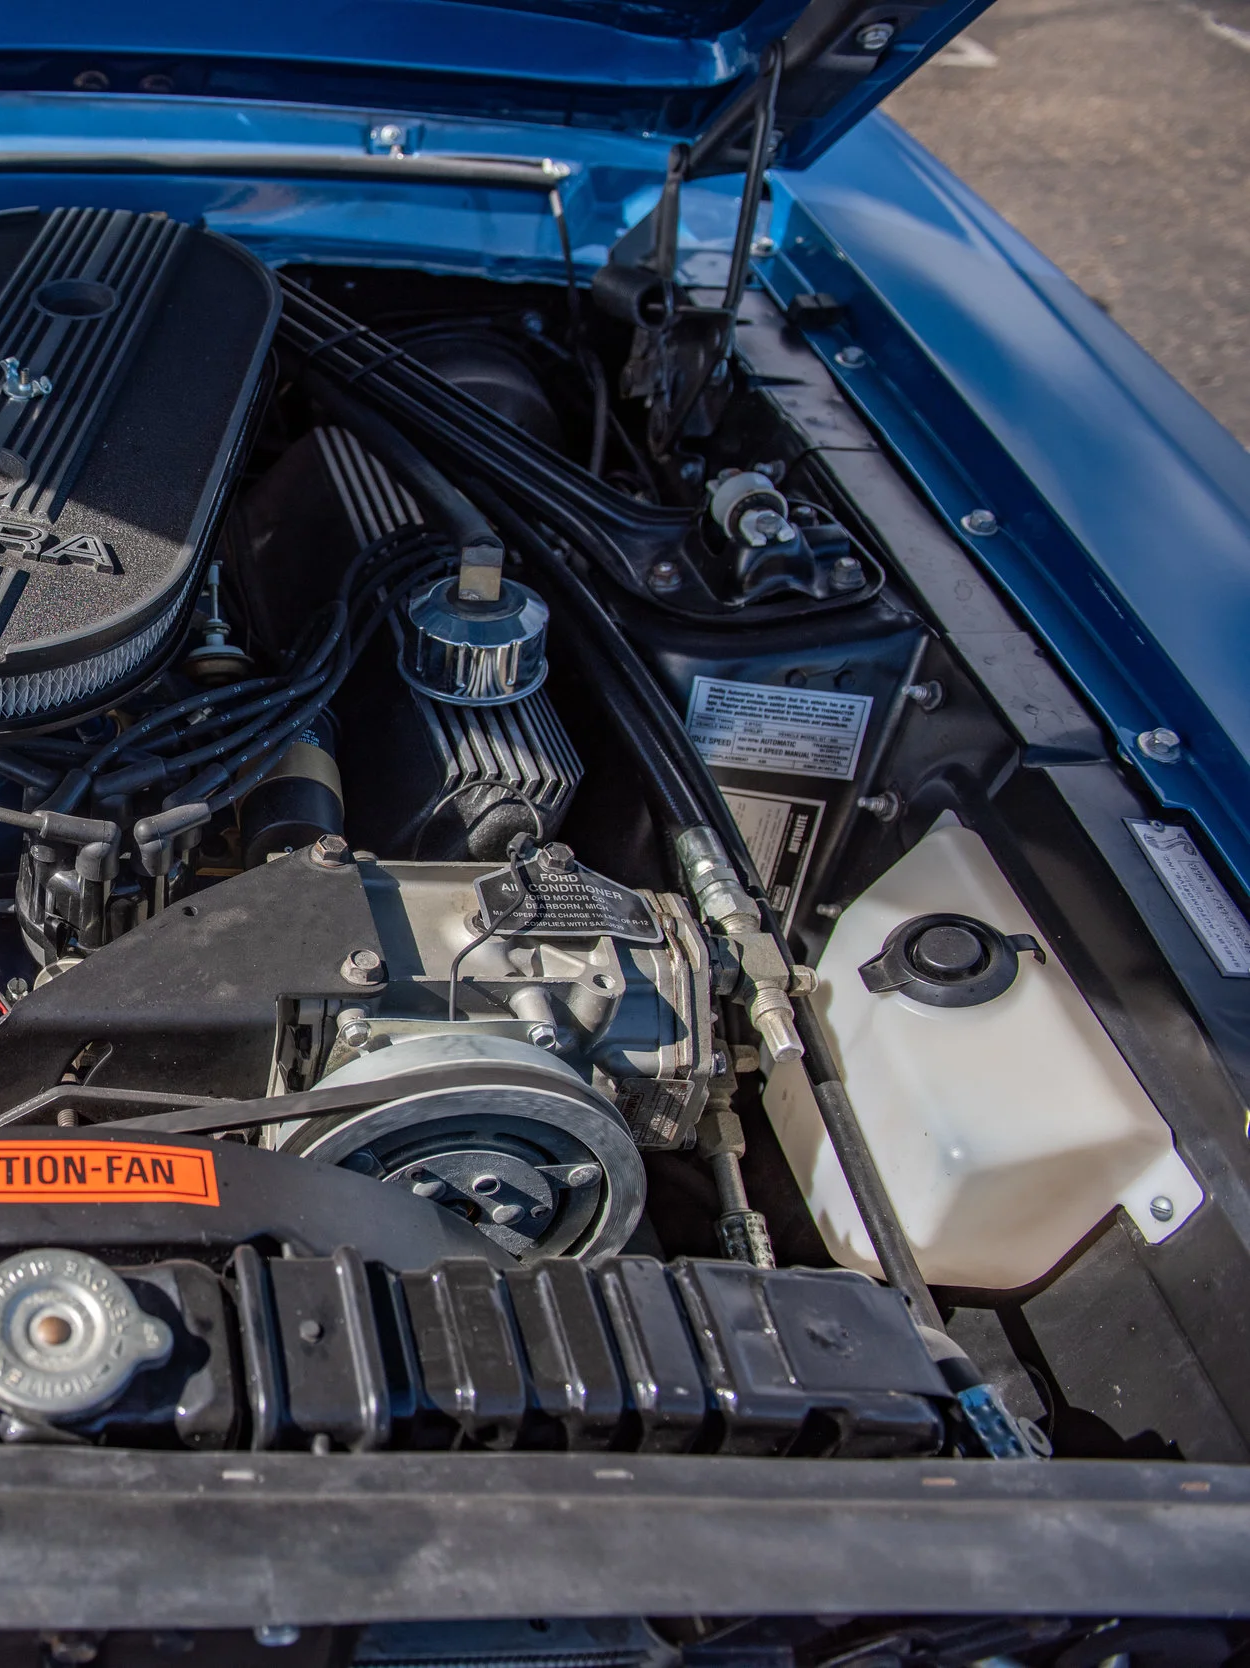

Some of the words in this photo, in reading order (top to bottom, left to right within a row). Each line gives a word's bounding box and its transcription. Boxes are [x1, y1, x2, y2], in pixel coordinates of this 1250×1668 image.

[708, 737, 731, 746] SPEED
[760, 738, 796, 747] AUTOMATIC
[762, 747, 783, 755] SPEED
[784, 749, 809, 758] MANUAL
[788, 814, 809, 854] AUTOLITE
[540, 873, 578, 882] FORD
[502, 883, 518, 891] AI
[529, 884, 623, 900] CONDITIONER
[585, 903, 612, 912] MICH.
